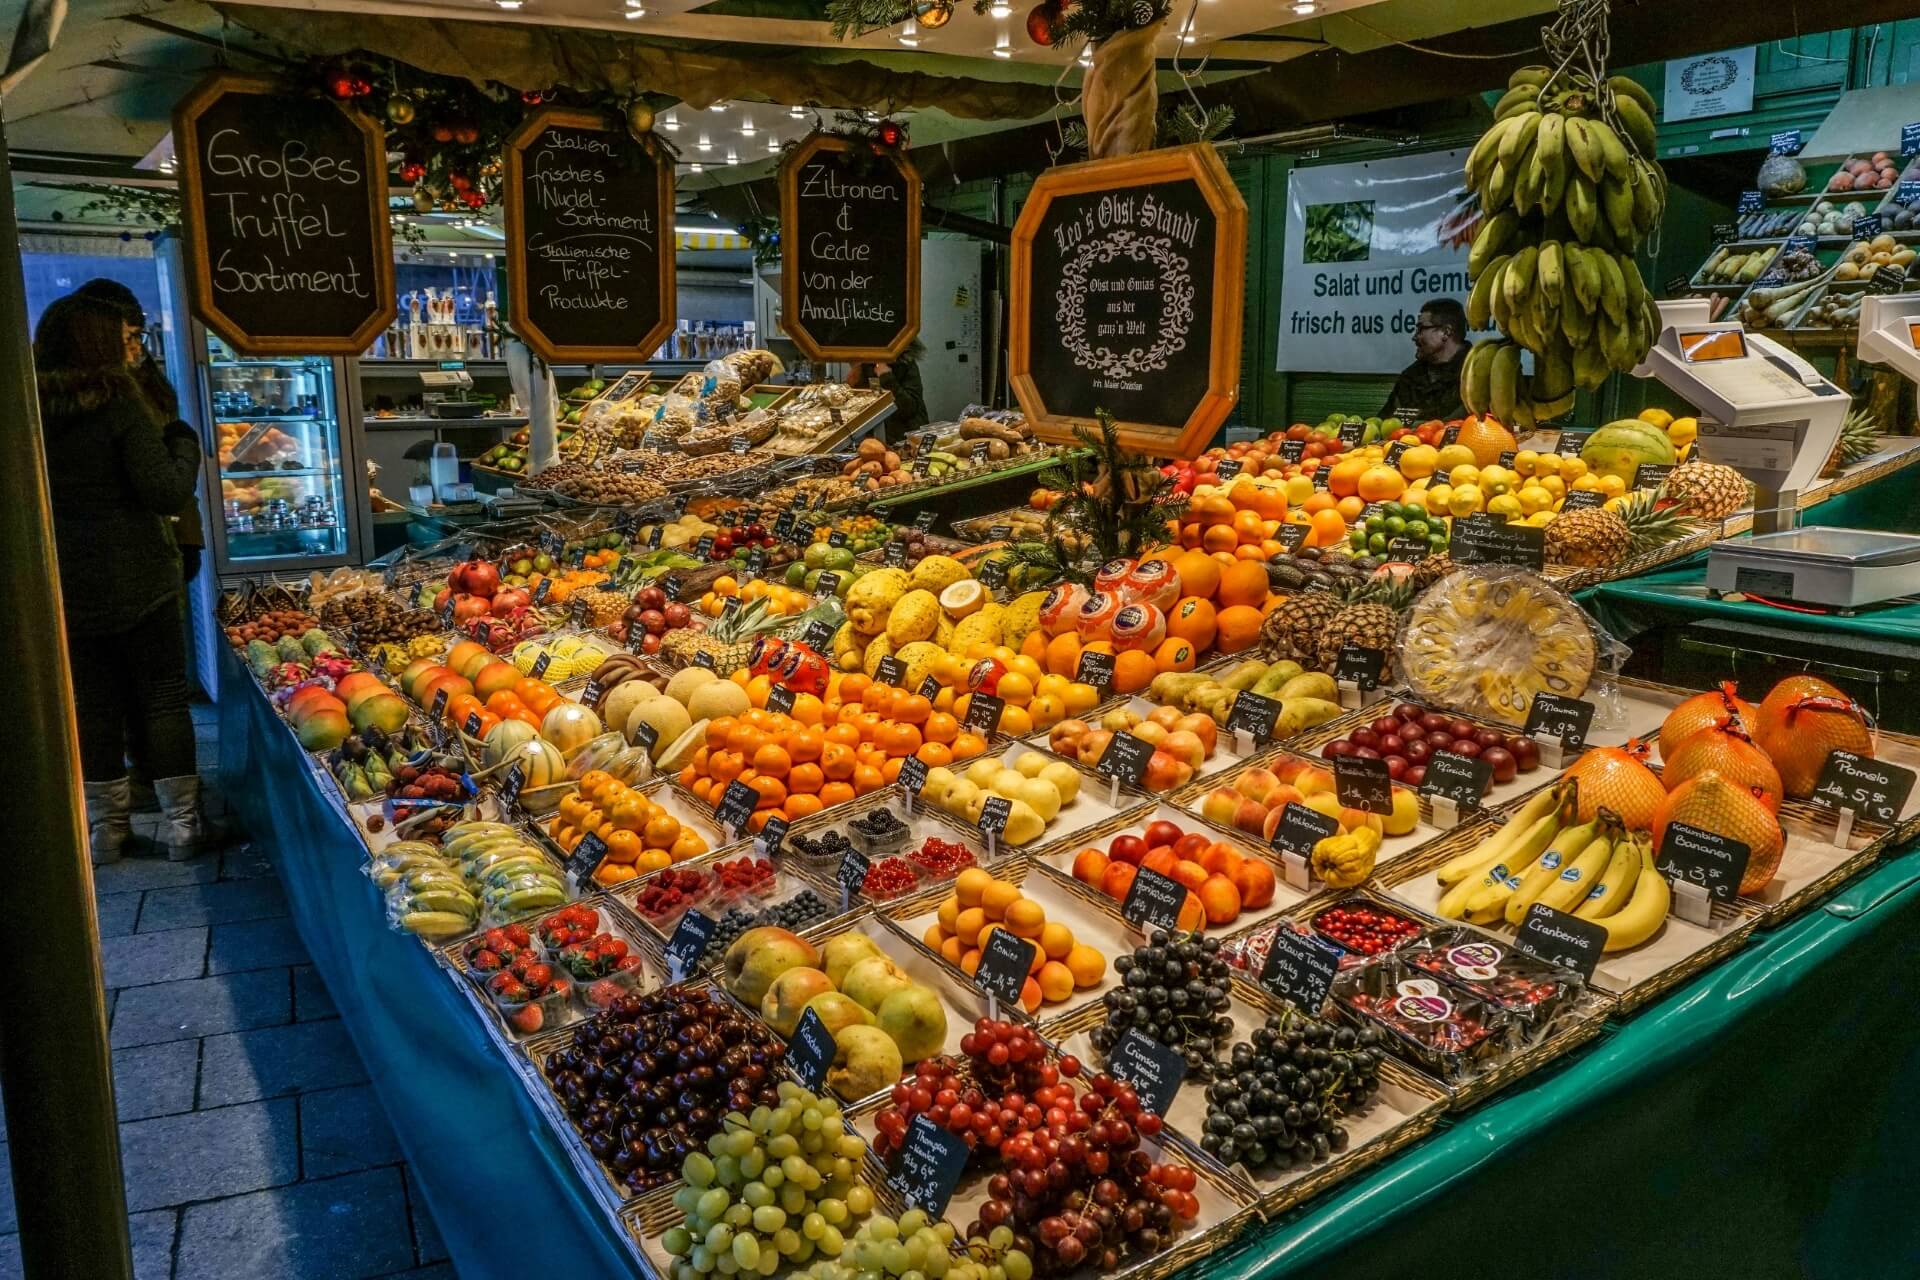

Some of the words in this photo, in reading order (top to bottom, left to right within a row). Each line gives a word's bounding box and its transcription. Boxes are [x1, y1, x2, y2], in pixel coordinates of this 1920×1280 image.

[544, 130, 617, 157] Italien
[207, 129, 361, 193] Großes
[527, 150, 605, 204] frisches
[800, 165, 899, 200] Zitronen
[542, 184, 607, 210] Nudel-
[209, 192, 347, 256] Trüffel
[555, 209, 654, 234] Sortiment
[1054, 207, 1094, 256] Leo's
[540, 243, 631, 260] Italienische
[811, 231, 871, 262] Cedre
[214, 249, 369, 299] Sortiment
[549, 259, 631, 290] Trüffel-
[803, 272, 836, 290] von
[841, 270, 873, 291] der
[1089, 278, 1109, 293] Obst
[1111, 279, 1125, 291] und
[1314, 273, 1360, 297] Salat
[1366, 270, 1404, 294] und
[540, 284, 629, 310] Produkte
[1106, 301, 1121, 312] aus
[1122, 300, 1136, 313] der
[801, 292, 895, 327] Amalfiküste
[1291, 311, 1345, 334] frisch
[1352, 316, 1385, 334] aus
[1391, 309, 1421, 333] de
[1126, 320, 1146, 335] Welt
[1537, 700, 1579, 717] Pflaumen
[1569, 735, 1581, 745] €
[1833, 751, 1859, 761] Asien
[1433, 760, 1473, 779] Pfirsiche
[1835, 760, 1889, 785] Pomelo
[1467, 796, 1476, 804] €
[1878, 806, 1894, 819] €
[1672, 822, 1724, 845] Kolumbien
[1674, 834, 1732, 862] Bananen
[1716, 885, 1728, 897] €
[1534, 905, 1553, 918] USA
[1528, 918, 1590, 949] Cranberries
[1277, 937, 1304, 960] Blaue
[1305, 952, 1333, 977] Traube
[1009, 988, 1018, 999] €
[1267, 973, 1290, 993] 1kg
[1319, 986, 1326, 996] €
[1311, 1003, 1321, 1014] €
[1125, 1042, 1160, 1073] Crimson
[1146, 1092, 1156, 1104] €
[915, 1128, 948, 1156] Thompson
[927, 1181, 938, 1193] €
[927, 1200, 937, 1213] €
